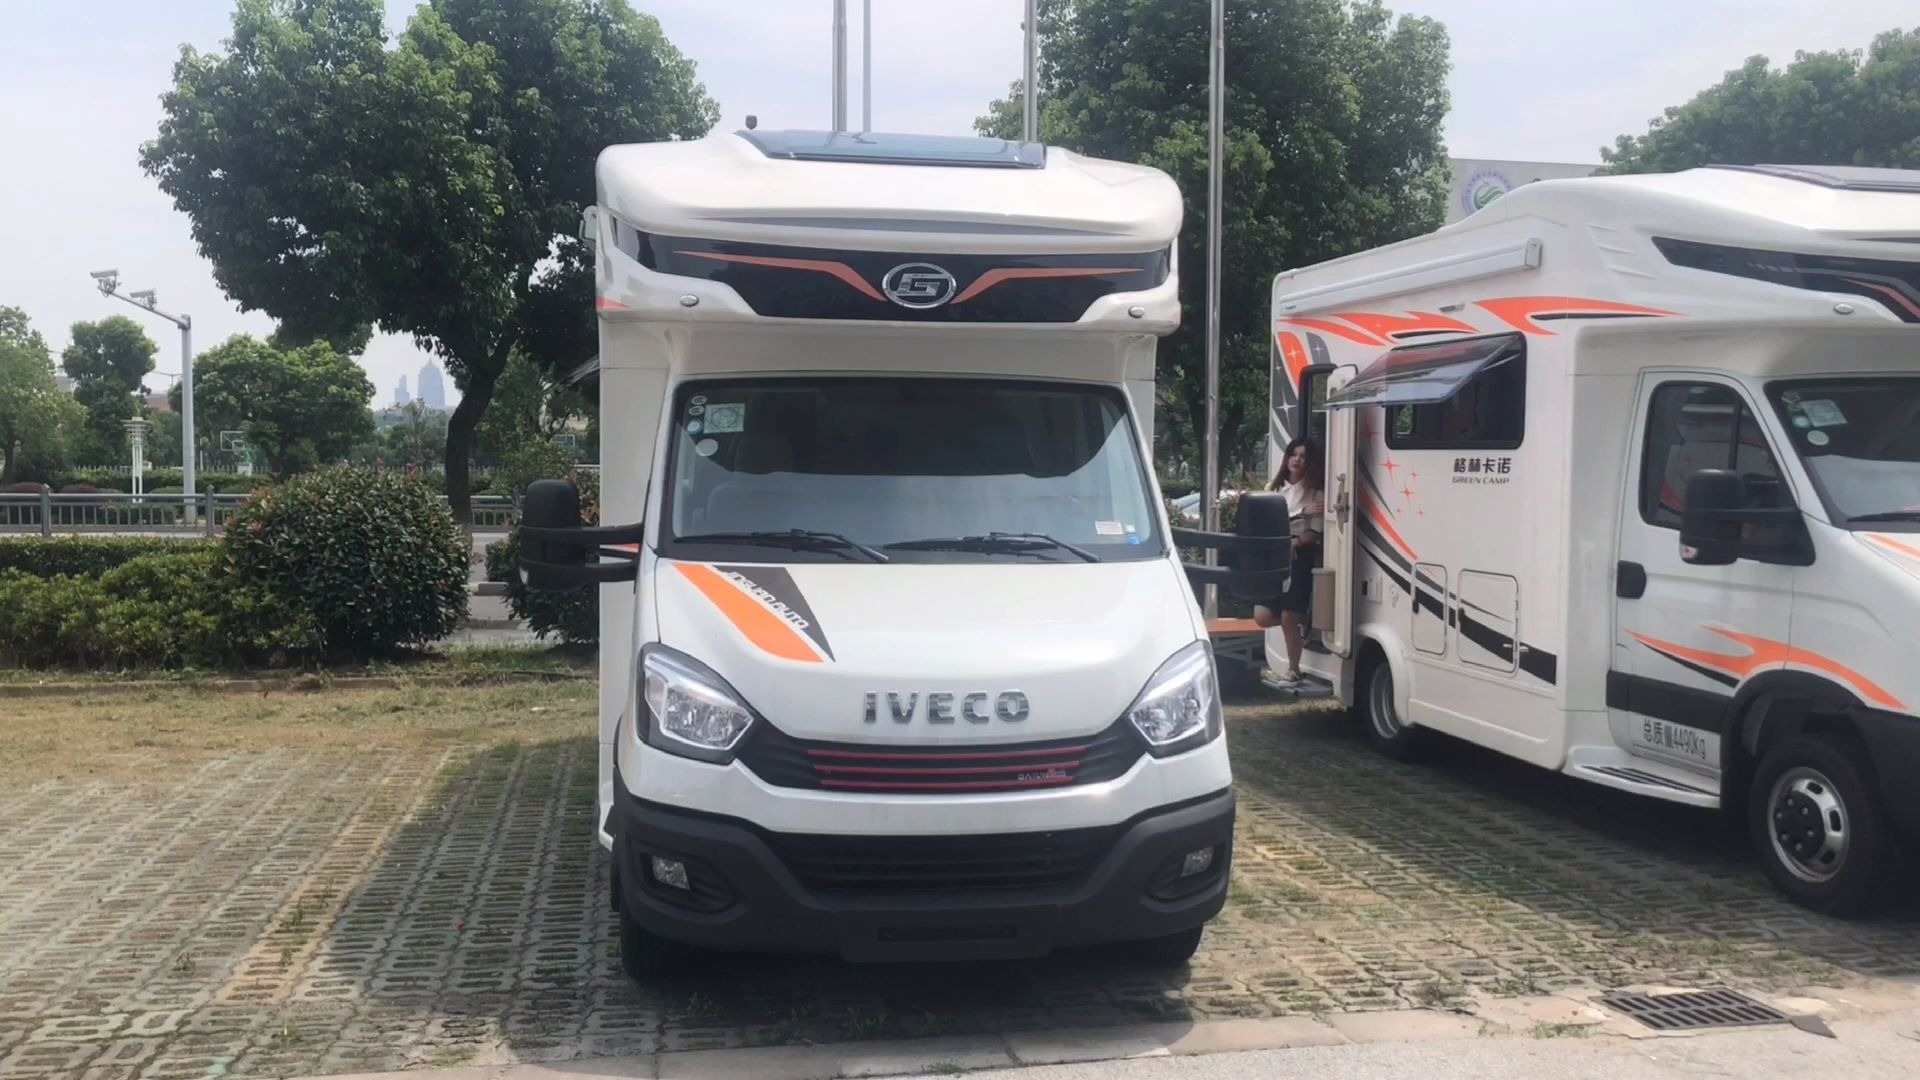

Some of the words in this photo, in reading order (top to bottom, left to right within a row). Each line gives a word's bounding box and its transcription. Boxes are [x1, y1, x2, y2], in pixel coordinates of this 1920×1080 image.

[1453, 457, 1511, 474] 格林卡诺
[1452, 475, 1480, 484] GREEN
[1482, 476, 1510, 485] CAMP
[864, 689, 1030, 724] IVECO
